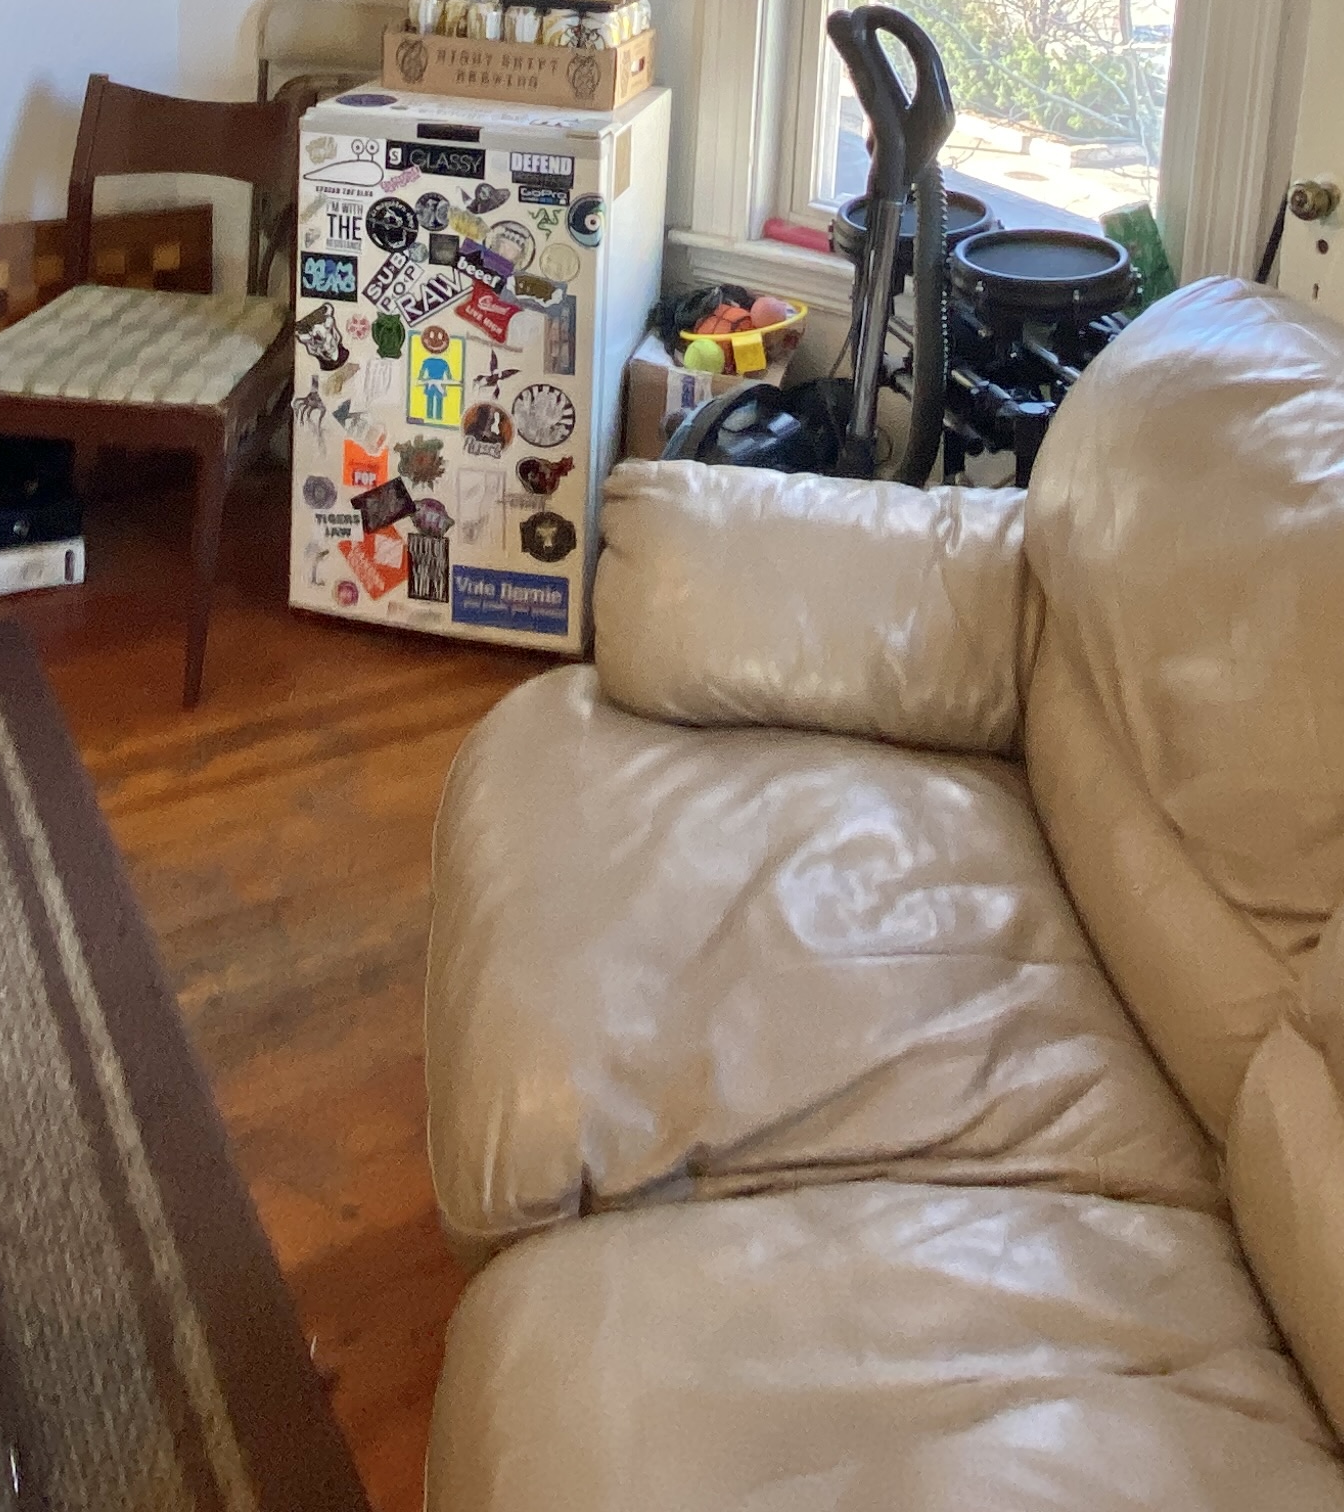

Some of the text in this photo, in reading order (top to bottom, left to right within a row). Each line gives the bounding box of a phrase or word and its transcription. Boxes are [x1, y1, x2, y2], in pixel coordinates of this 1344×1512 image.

[409, 148, 483, 173] GLASSY
[511, 152, 573, 176] DEFEND
[520, 187, 568, 199] GoPro
[341, 202, 364, 216] WITH
[326, 213, 363, 241] THE
[395, 268, 463, 322] RAW
[354, 470, 378, 486] POP
[314, 513, 361, 525] TIGERS
[455, 575, 563, 605] Vote Bernie
